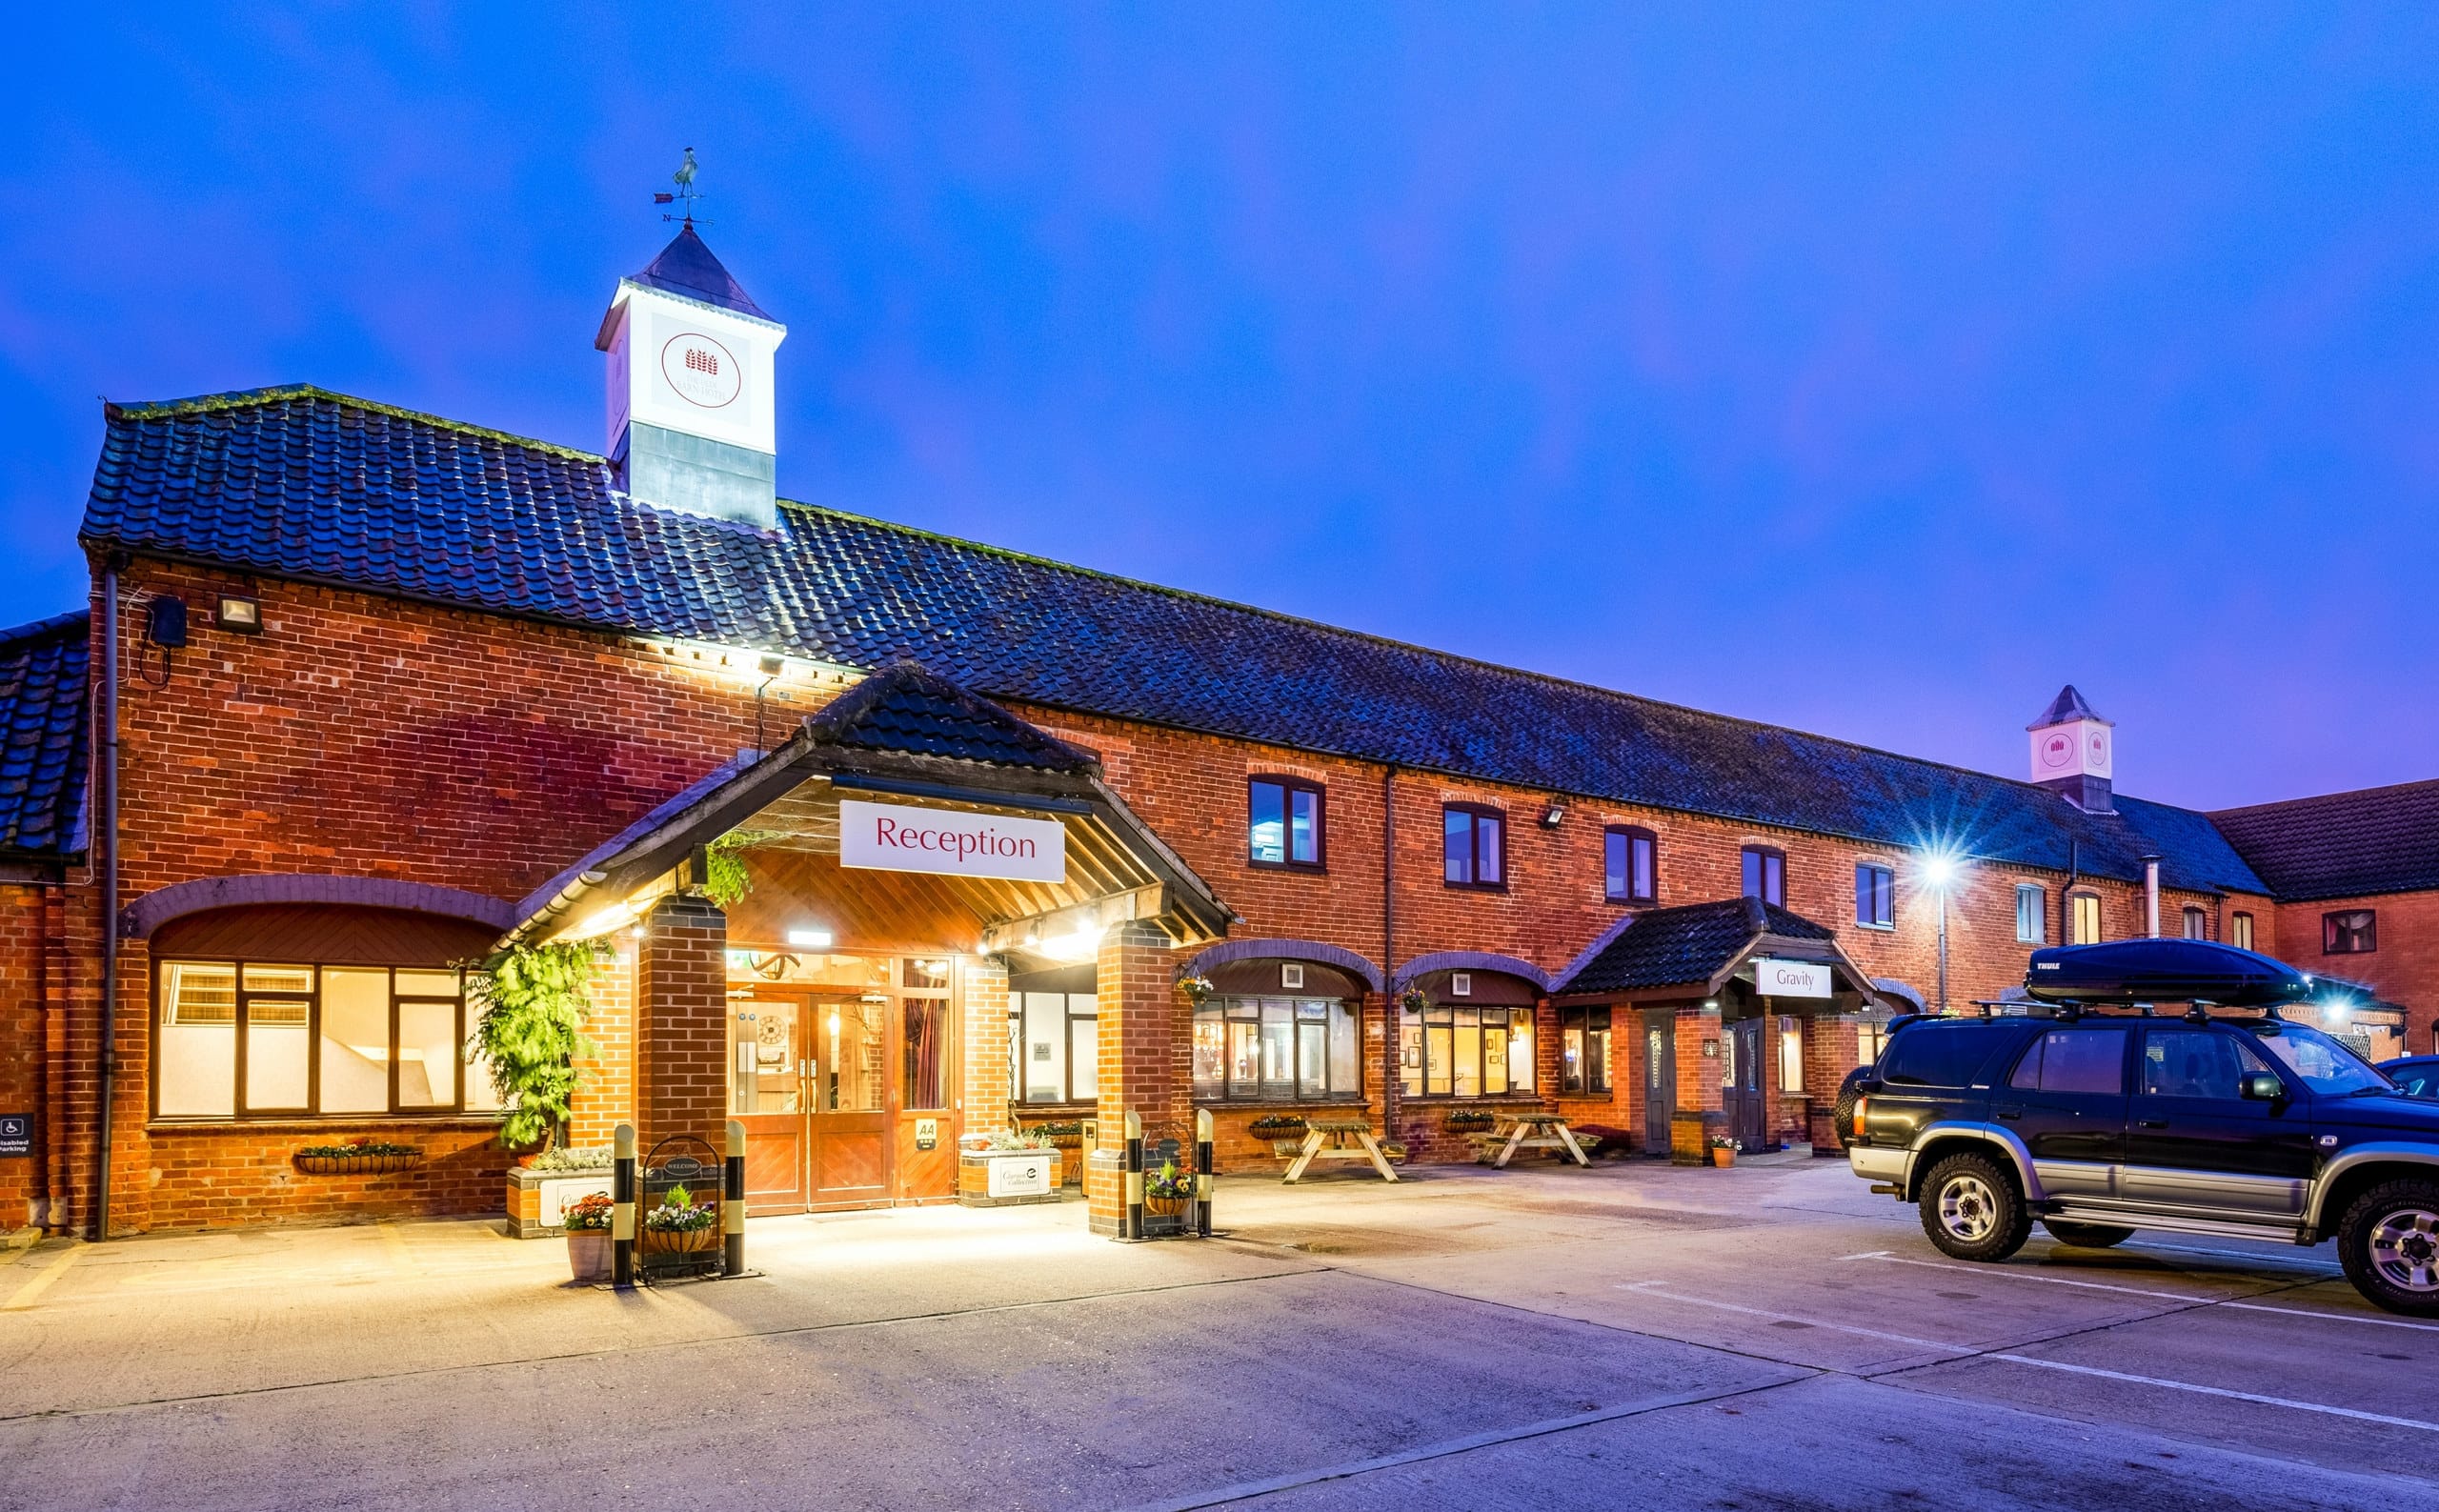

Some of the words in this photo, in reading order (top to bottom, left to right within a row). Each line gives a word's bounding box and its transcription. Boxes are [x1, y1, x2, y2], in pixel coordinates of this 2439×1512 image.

[877, 816, 1036, 861] Reception
[1776, 969, 1814, 991] Gravity
[918, 1124, 935, 1136] AA
